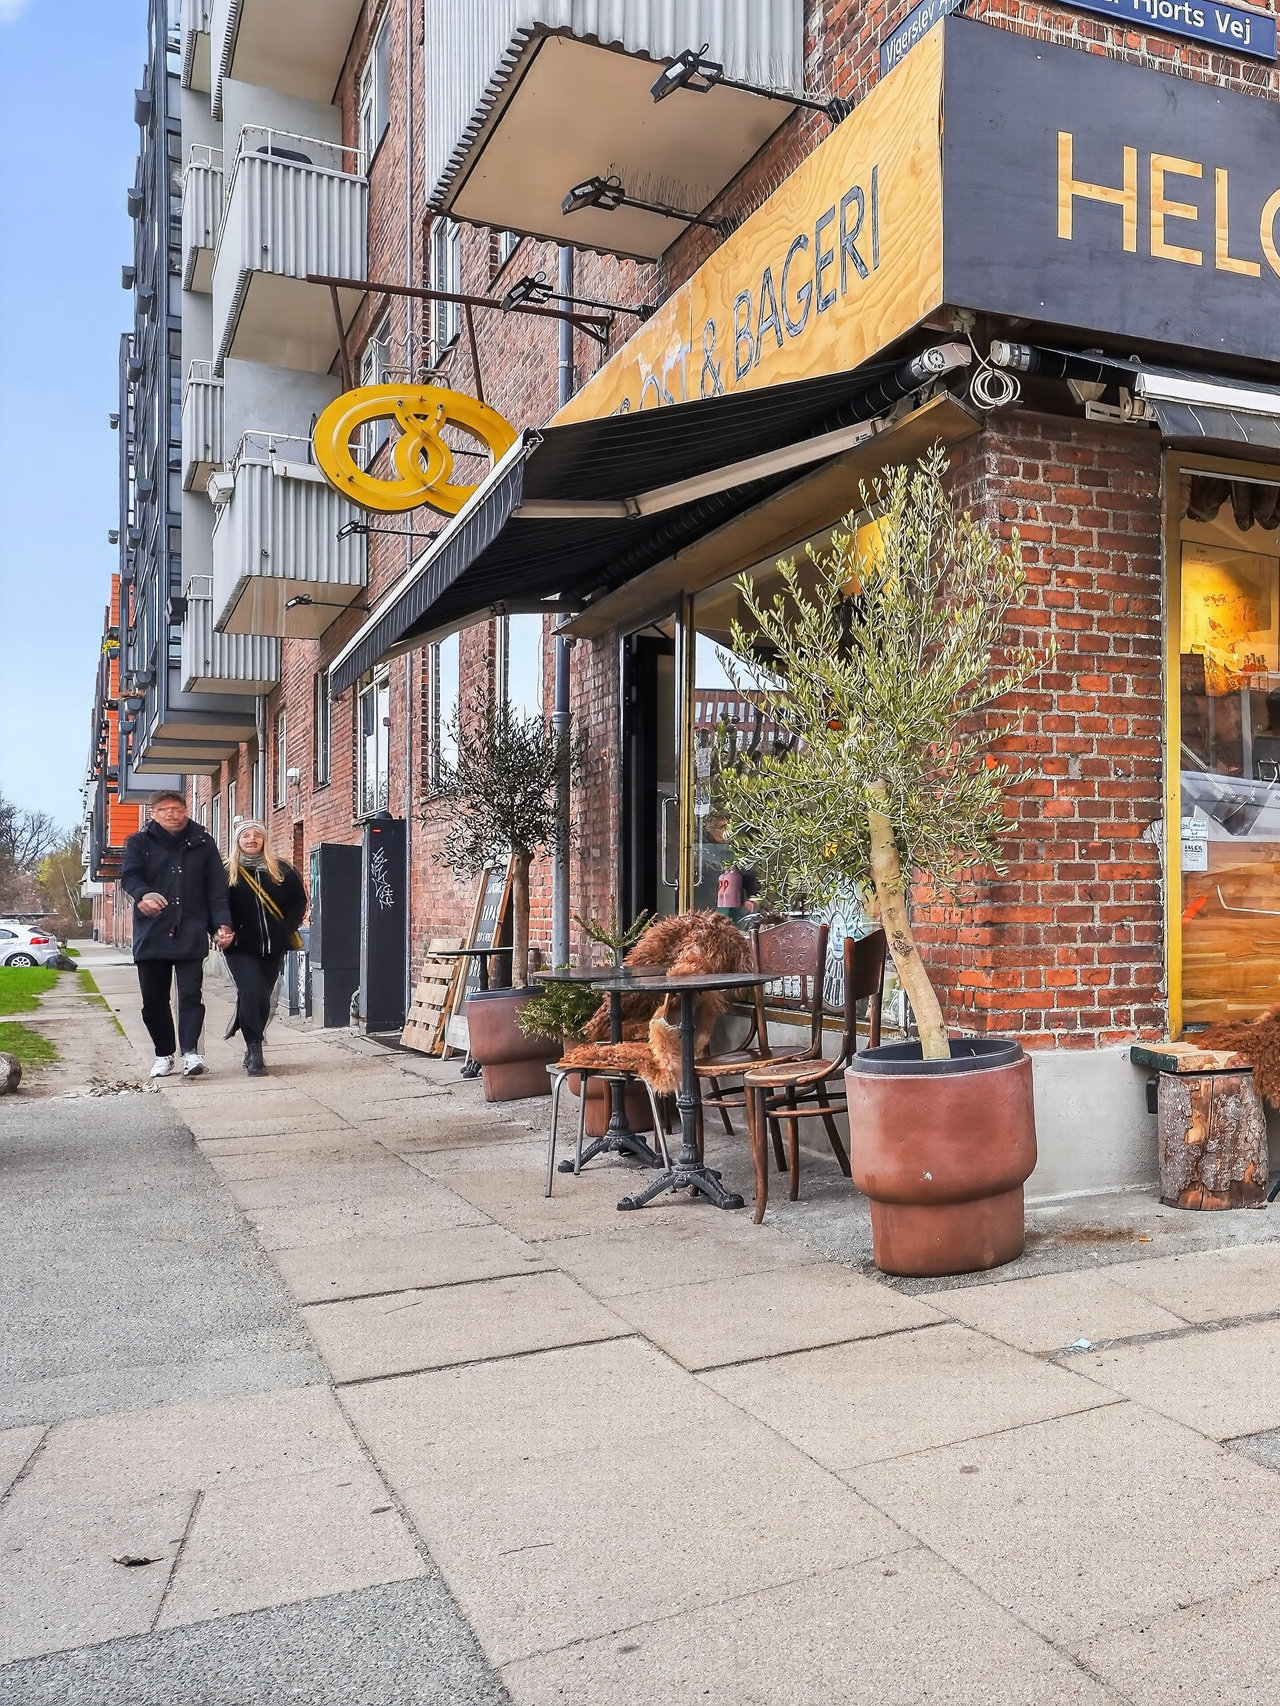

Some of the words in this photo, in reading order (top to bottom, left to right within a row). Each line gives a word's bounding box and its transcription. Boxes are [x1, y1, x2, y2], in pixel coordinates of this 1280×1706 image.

[886, 2, 935, 65] Vigerslev
[1214, 9, 1251, 45] Vej
[701, 317, 724, 400] &
[733, 164, 880, 383] BAGERI
